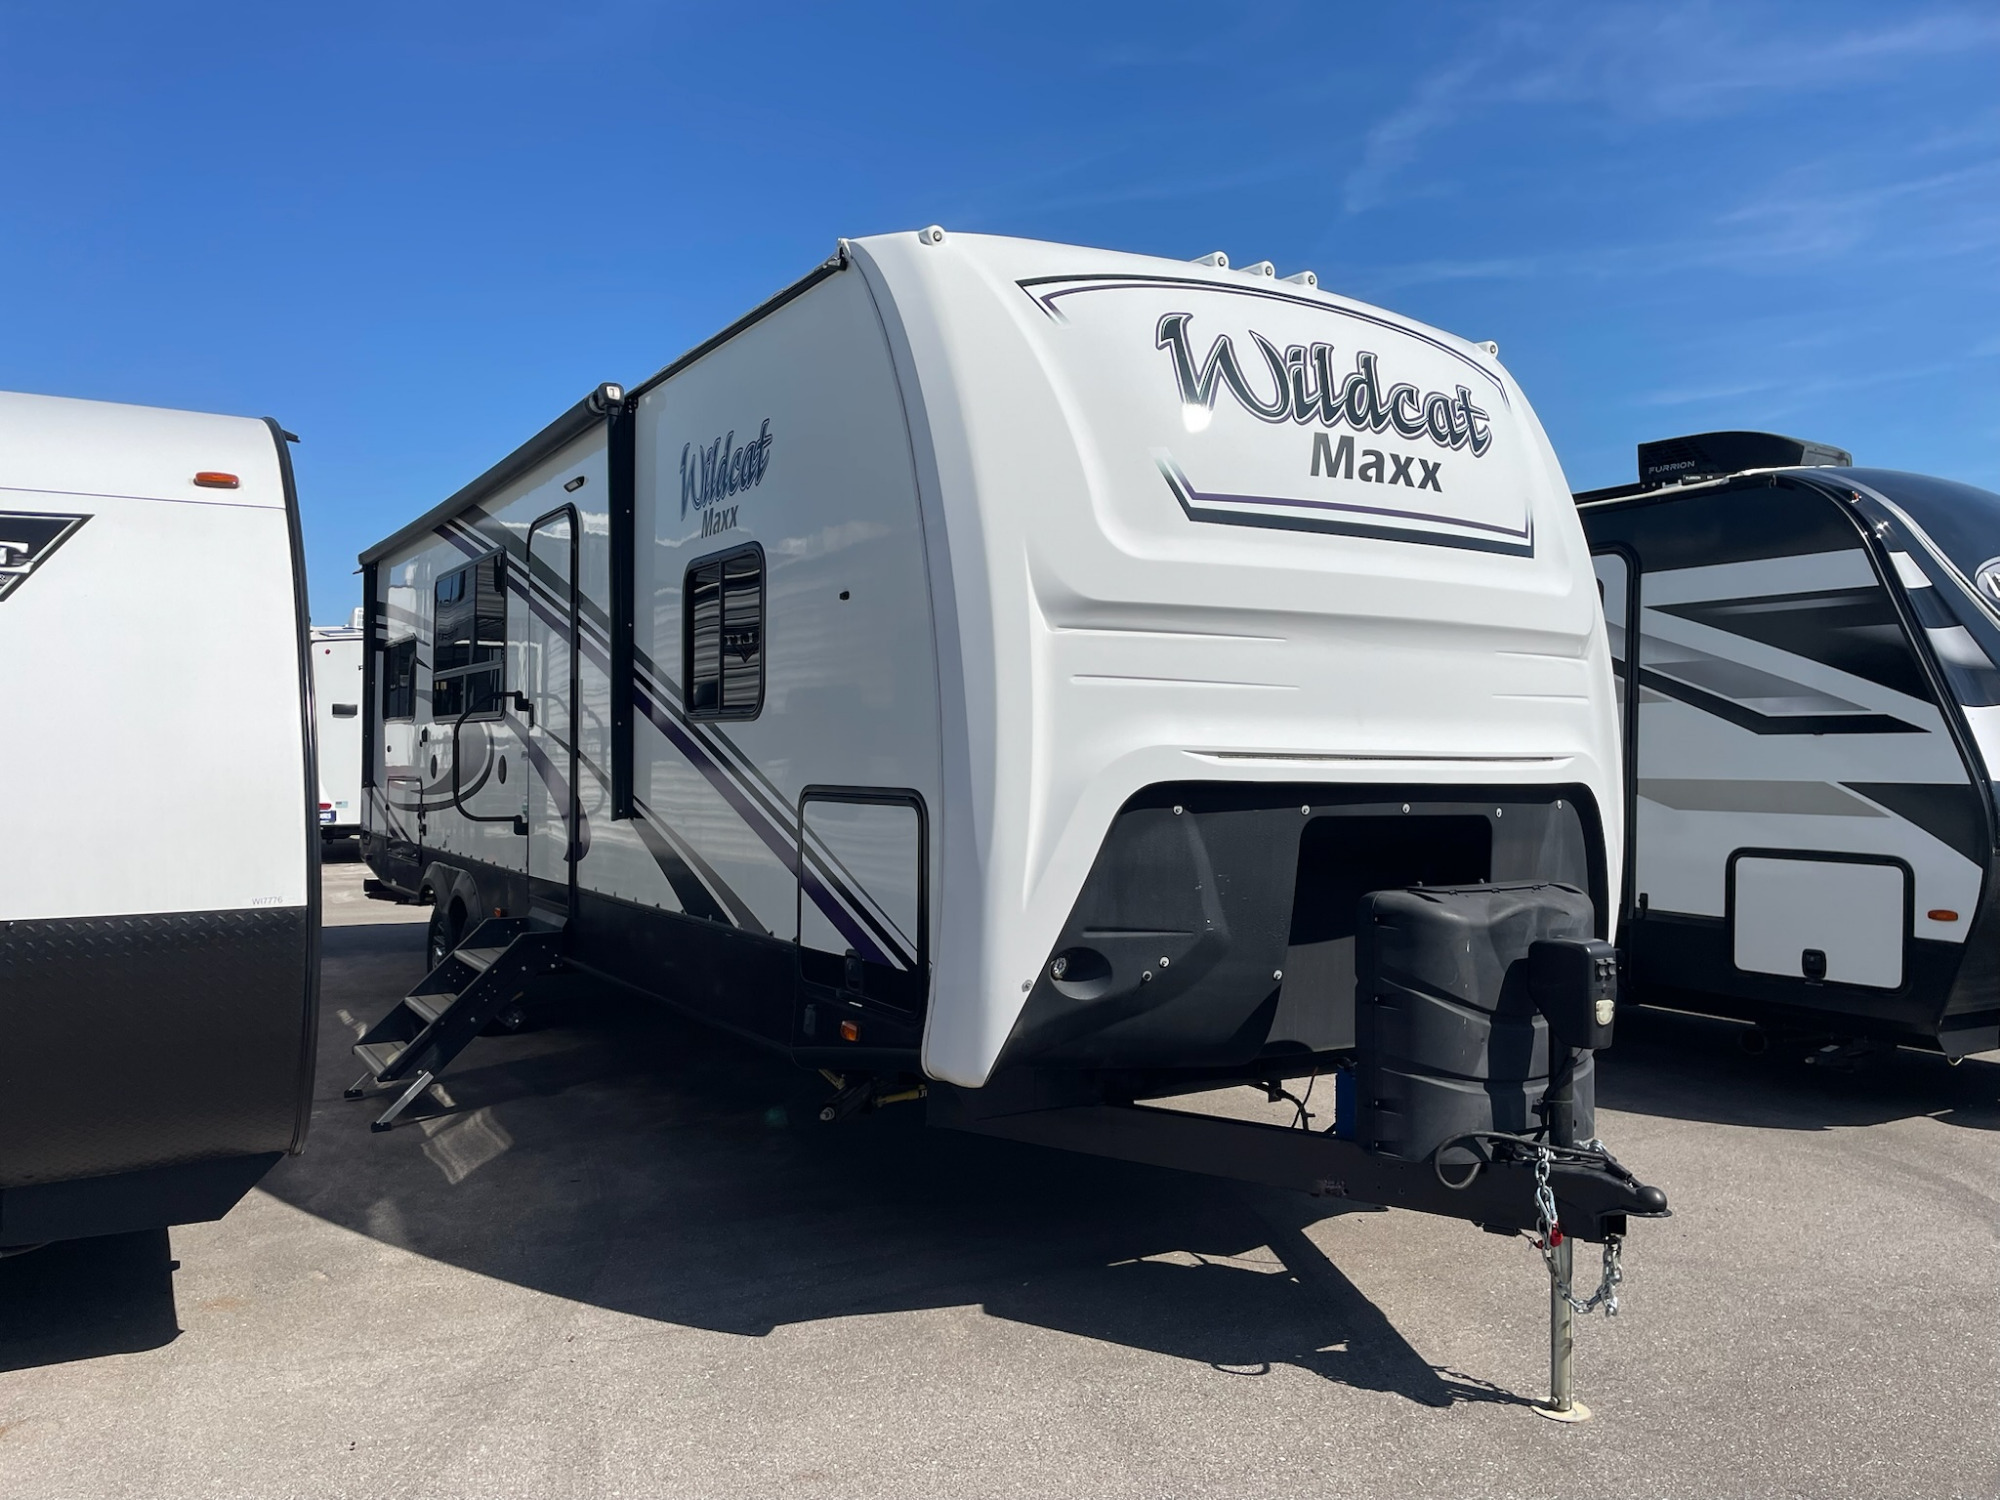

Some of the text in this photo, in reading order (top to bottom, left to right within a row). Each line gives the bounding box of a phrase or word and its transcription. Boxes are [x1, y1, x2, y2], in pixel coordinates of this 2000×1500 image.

[1155, 312, 1492, 458] Wildcat
[679, 417, 773, 522] Wildcat
[1310, 432, 1443, 493] Maxx
[1647, 460, 1695, 474] FURRION
[701, 504, 739, 539] Maxx
